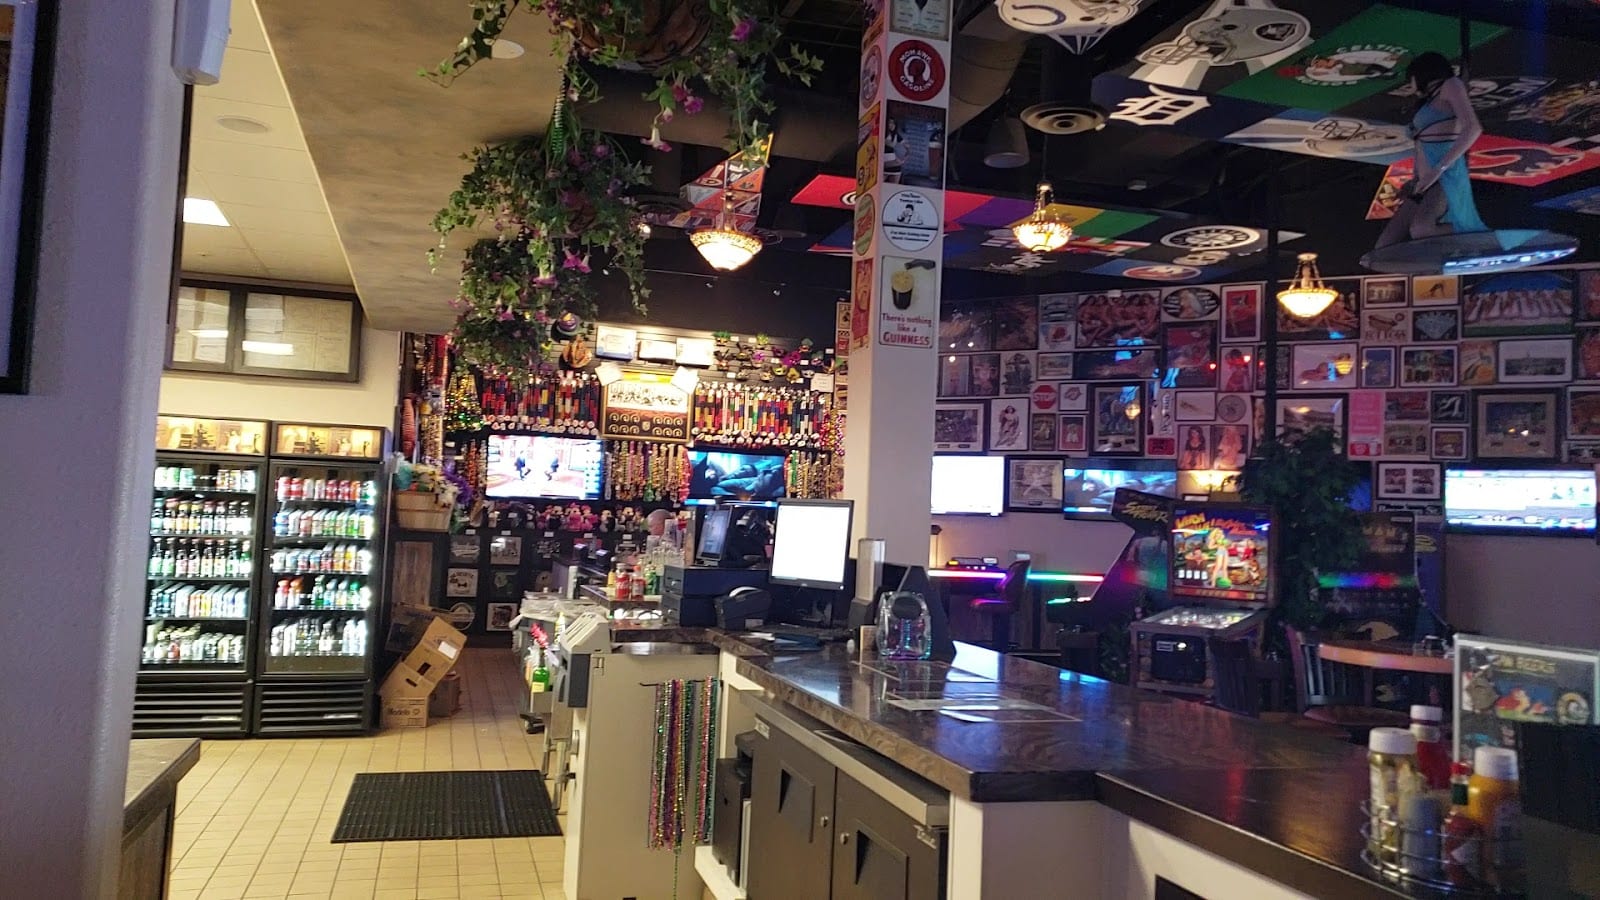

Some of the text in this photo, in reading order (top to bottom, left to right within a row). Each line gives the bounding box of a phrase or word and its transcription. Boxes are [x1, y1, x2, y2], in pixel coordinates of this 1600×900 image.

[899, 49, 932, 63] MOHAWK
[900, 75, 935, 91] GASOLINE
[881, 312, 932, 327] There's nothing
[897, 323, 911, 331] like
[883, 331, 930, 345] GUINNESS
[1033, 392, 1057, 401] STOP
